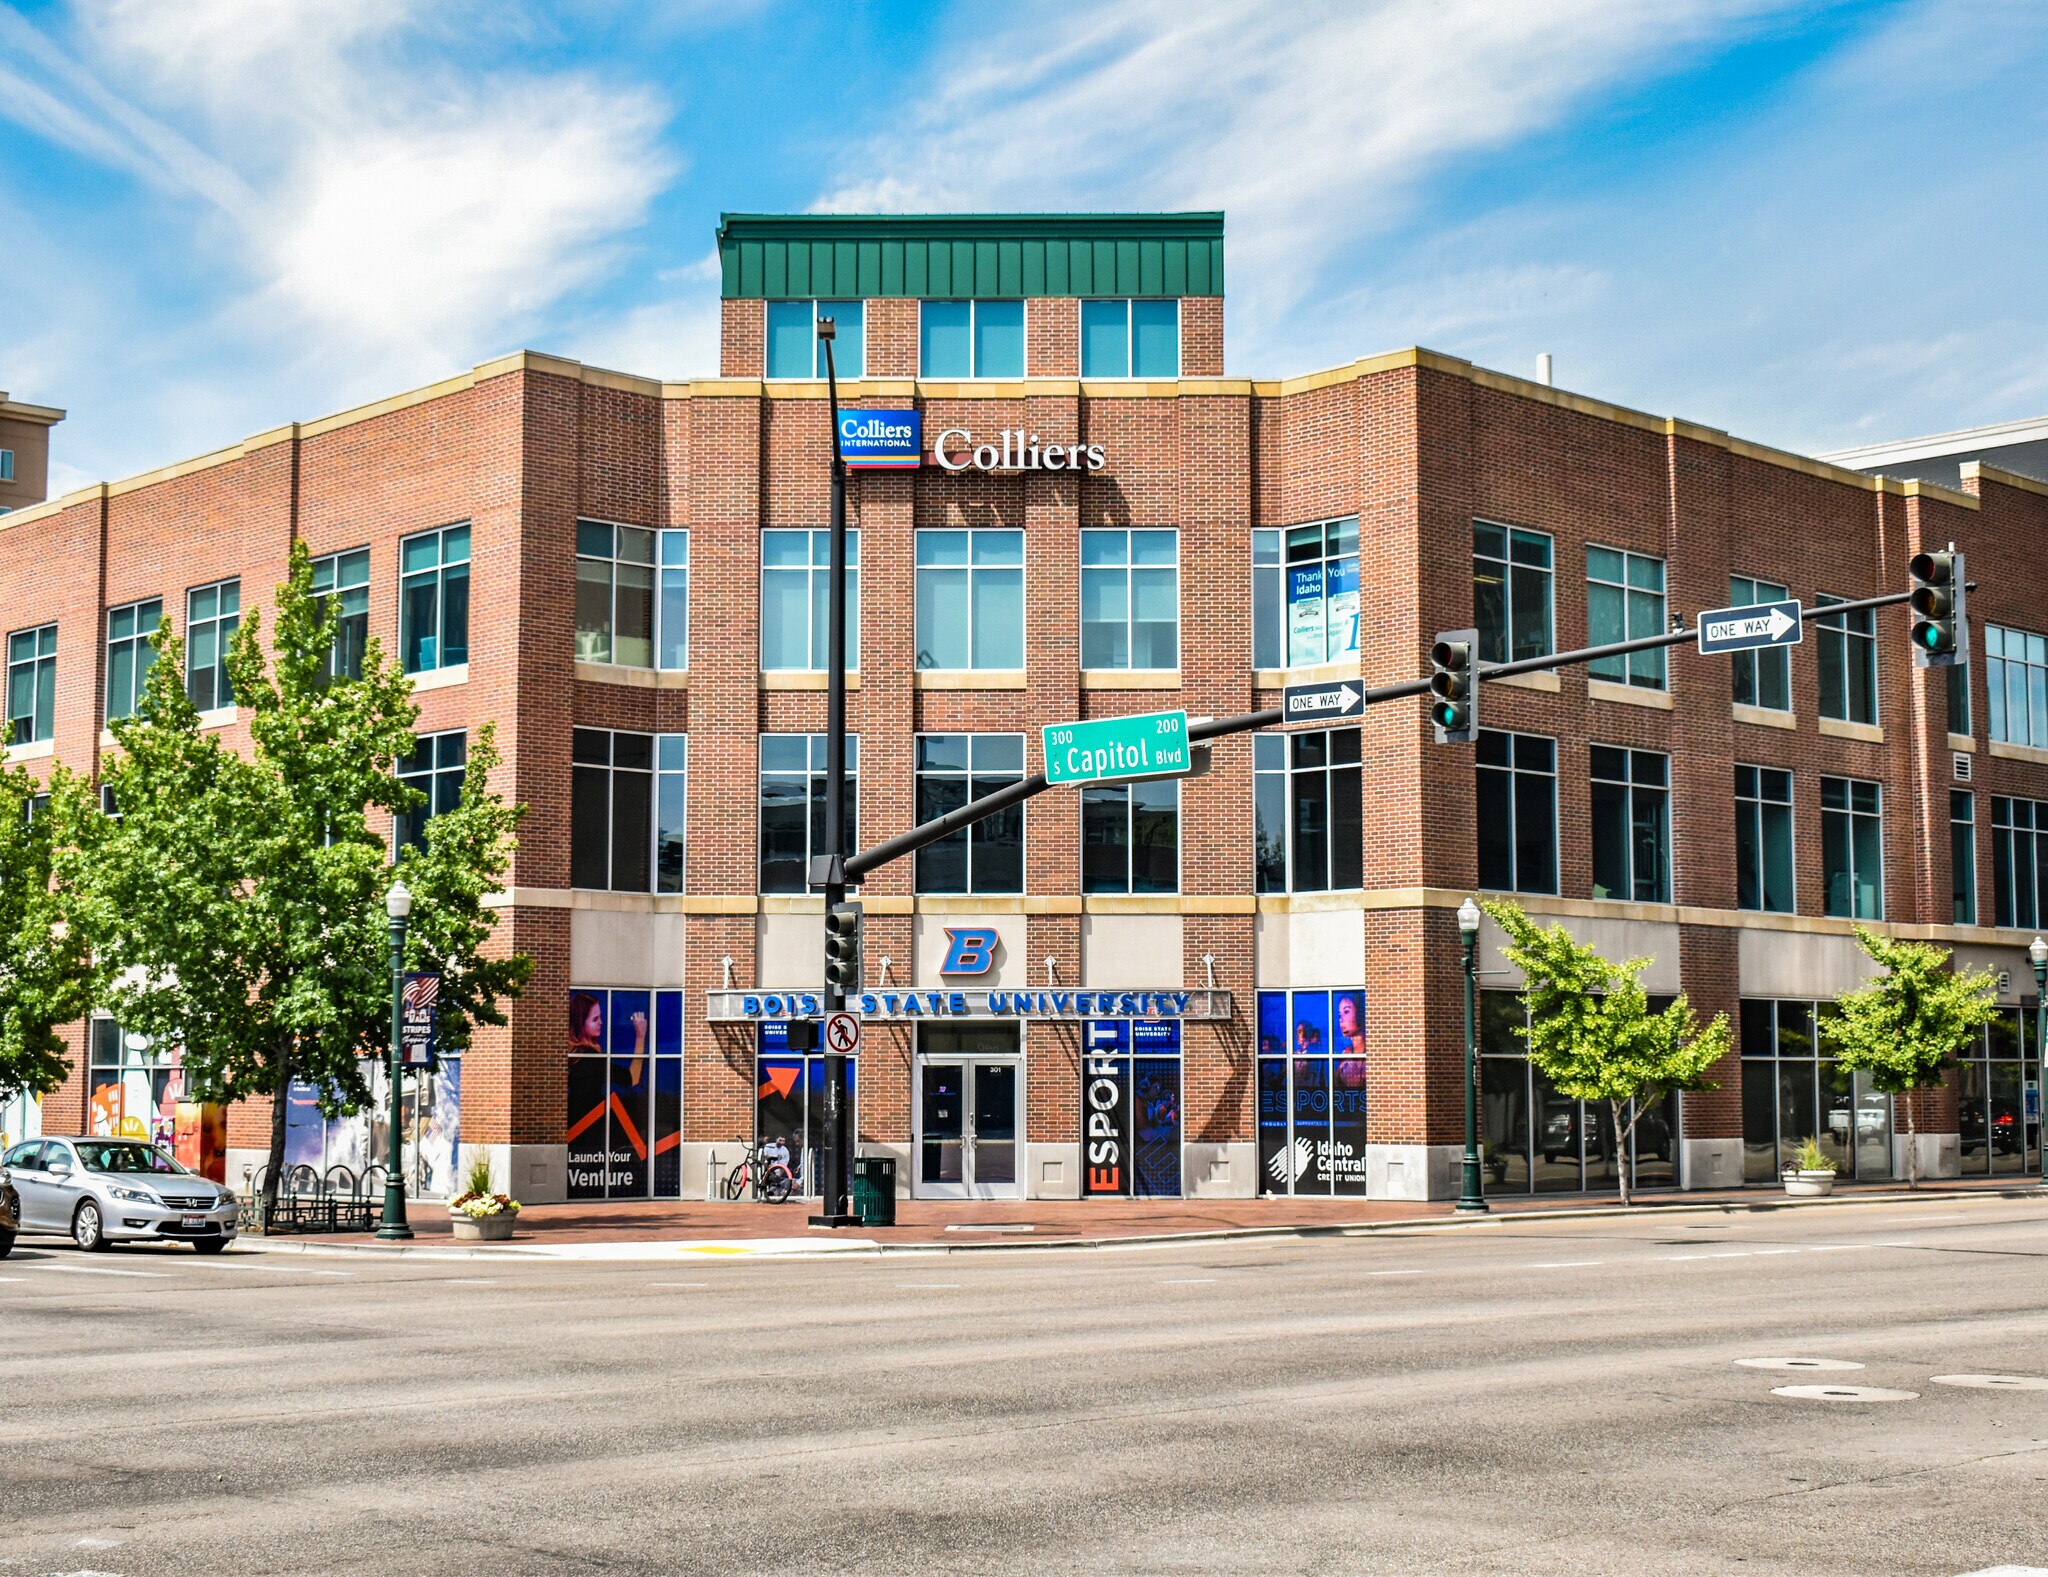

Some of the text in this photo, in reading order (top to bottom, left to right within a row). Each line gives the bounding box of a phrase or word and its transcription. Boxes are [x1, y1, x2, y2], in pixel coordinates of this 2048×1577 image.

[841, 419, 912, 438] Colliers
[841, 439, 912, 448] INTERNATIONAL
[934, 428, 1105, 471] Colliers
[1296, 570, 1323, 583] Thank
[1327, 567, 1345, 578] You
[1296, 583, 1321, 595] Idaho
[1293, 625, 1314, 634] Colliers
[1710, 618, 1771, 639] ONE WAY
[1292, 693, 1341, 710] ONE WAY
[1156, 718, 1179, 734] 200
[1051, 730, 1073, 746] 300
[1054, 738, 1182, 778] S Capitol Blvd
[939, 927, 999, 975] B
[743, 992, 1190, 1015] BOIS STATE UNIVERSITY
[402, 1025, 432, 1034] STRIPES
[1089, 1008, 1119, 1191] ESPORT
[1317, 1140, 1353, 1156] Idaho
[568, 1151, 632, 1163] Launch Your
[1317, 1156, 1366, 1172] Central
[568, 1168, 633, 1187] Venture
[1317, 1173, 1366, 1182] CREIT UNION
